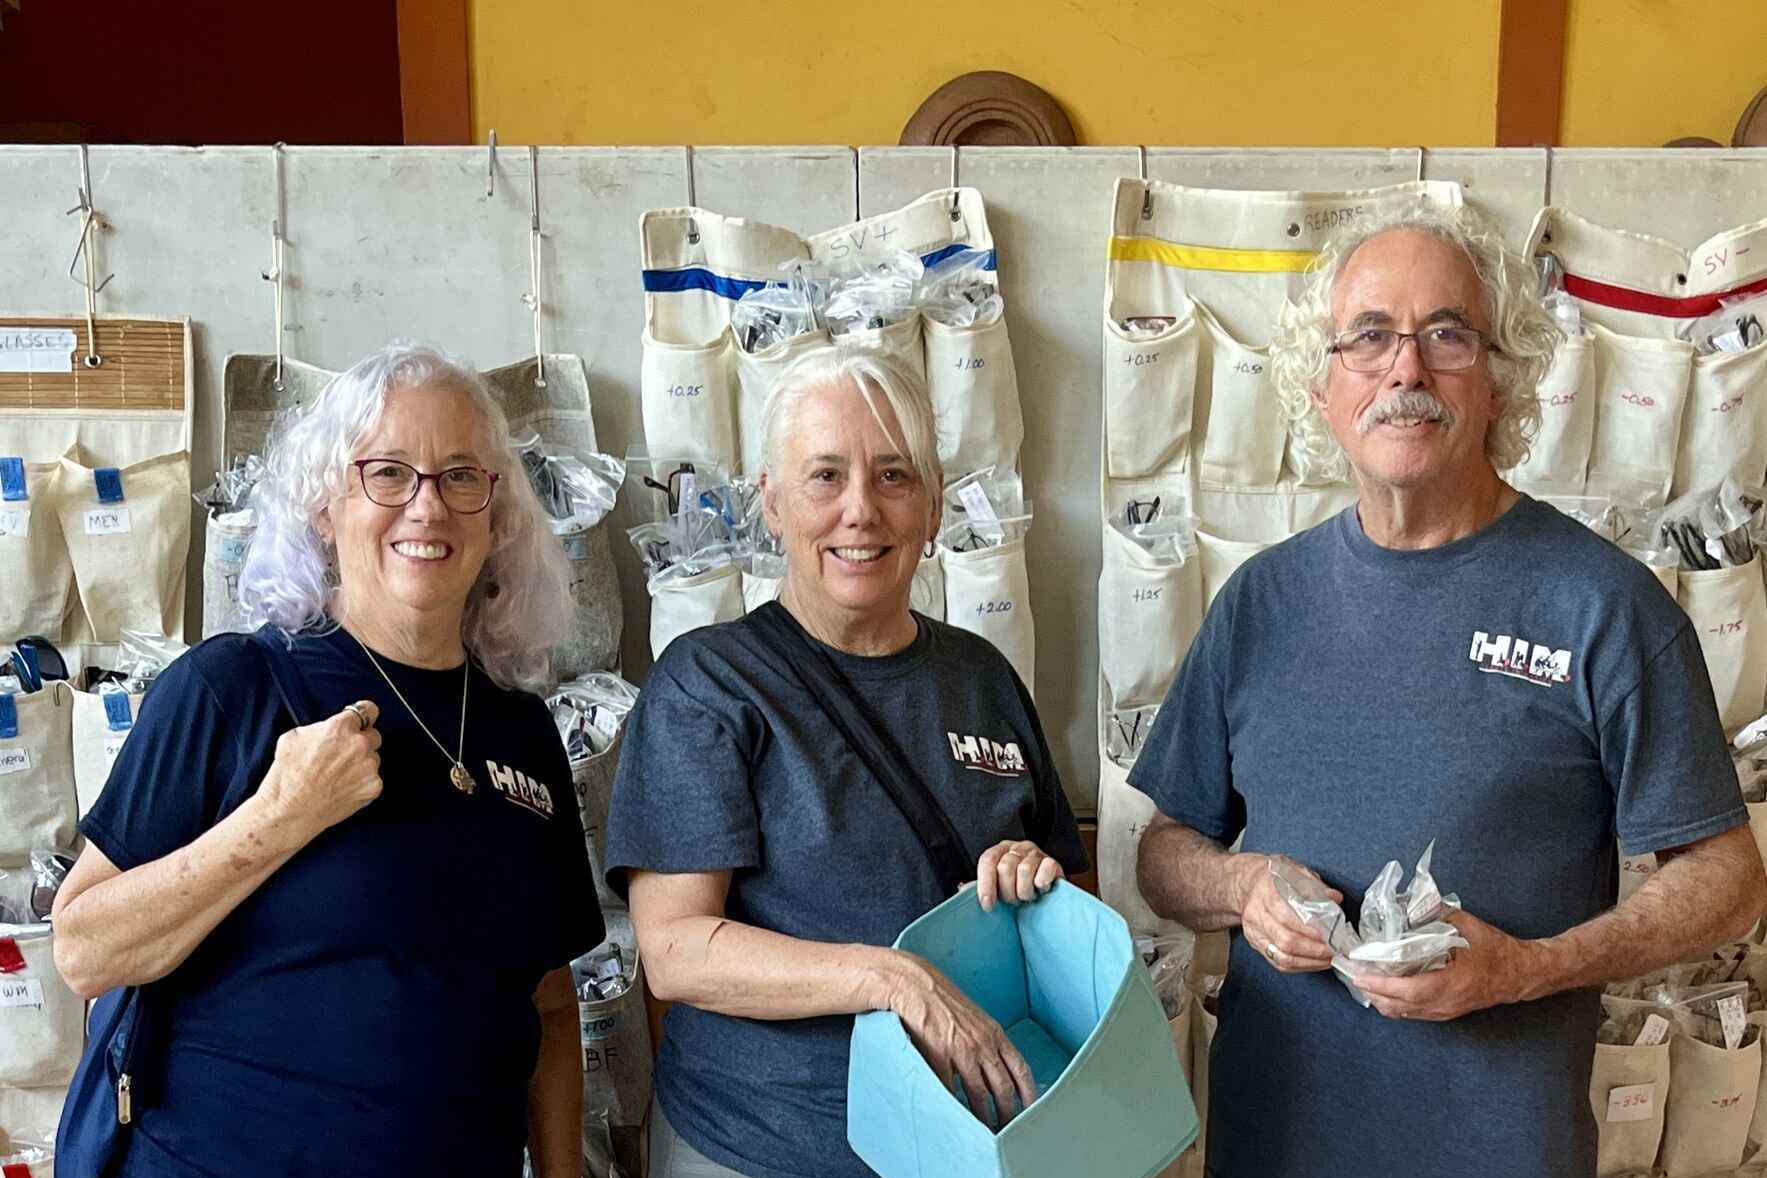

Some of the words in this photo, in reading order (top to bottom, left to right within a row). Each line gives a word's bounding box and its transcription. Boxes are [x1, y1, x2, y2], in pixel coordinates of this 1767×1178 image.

[829, 225, 869, 259] SV
[1704, 247, 1728, 276] SV
[666, 384, 704, 398] +0.25
